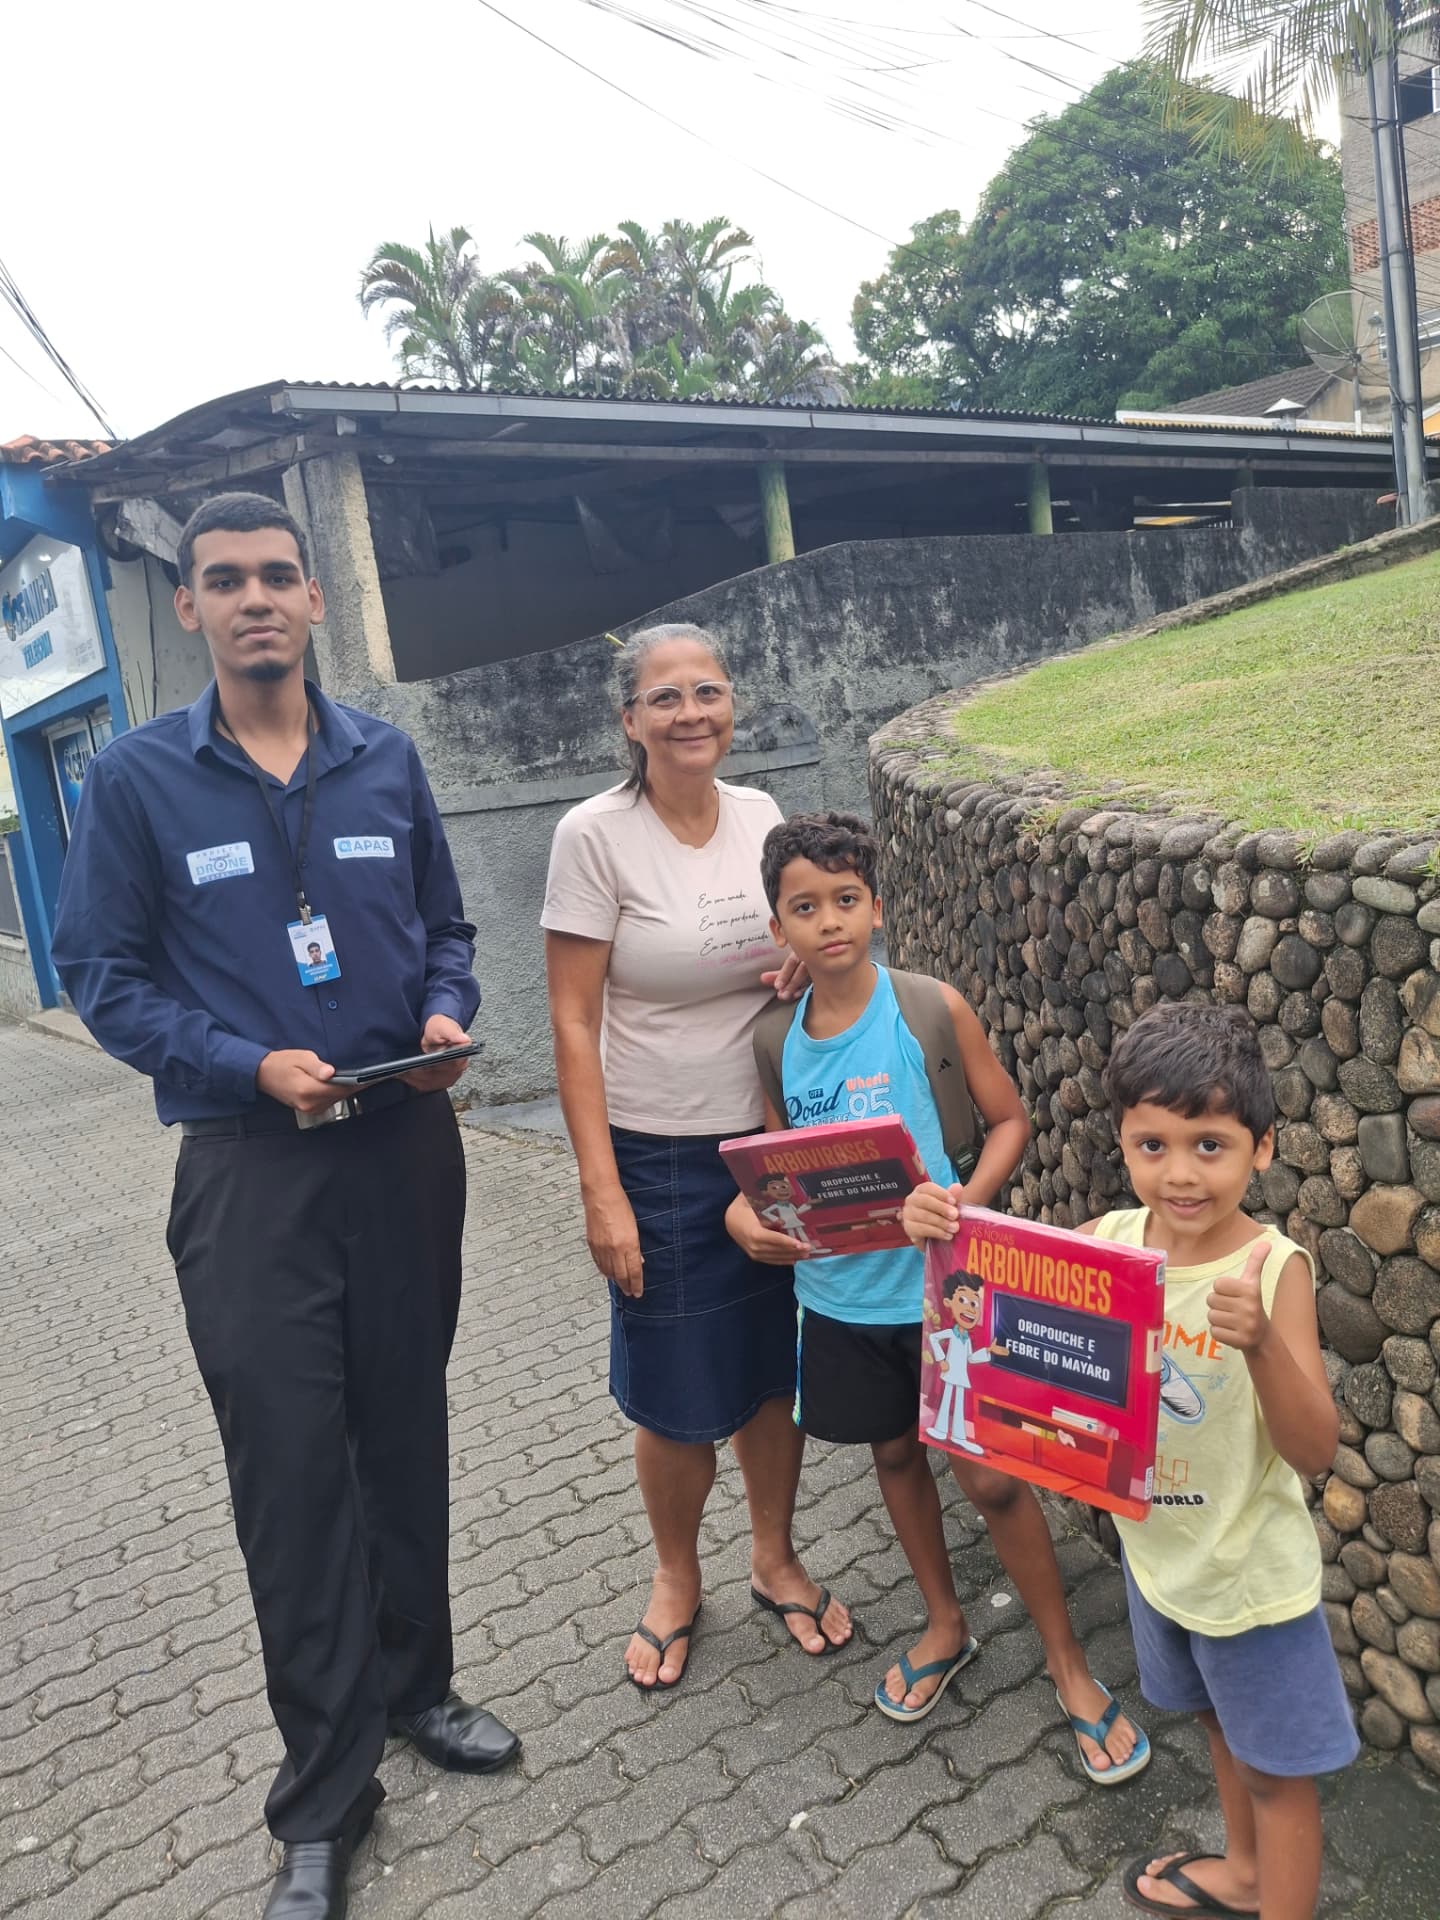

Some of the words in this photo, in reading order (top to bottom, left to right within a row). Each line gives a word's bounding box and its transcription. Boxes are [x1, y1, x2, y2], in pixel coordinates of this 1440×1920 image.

[195, 856, 249, 876] DRONE
[763, 1139, 880, 1174] ARBOVIROSES
[817, 1189, 844, 1199] FEBRE
[846, 1187, 859, 1195] DO
[820, 1174, 872, 1188] OROPOUCHE
[966, 1237, 1112, 1315] ARBOVIROSES
[1018, 1318, 1085, 1350] OROPOUCHE
[1087, 1339, 1096, 1353] E
[1006, 1338, 1040, 1360] FEBRE
[1043, 1349, 1059, 1365] DO
[1062, 1355, 1110, 1382] MAYARO
